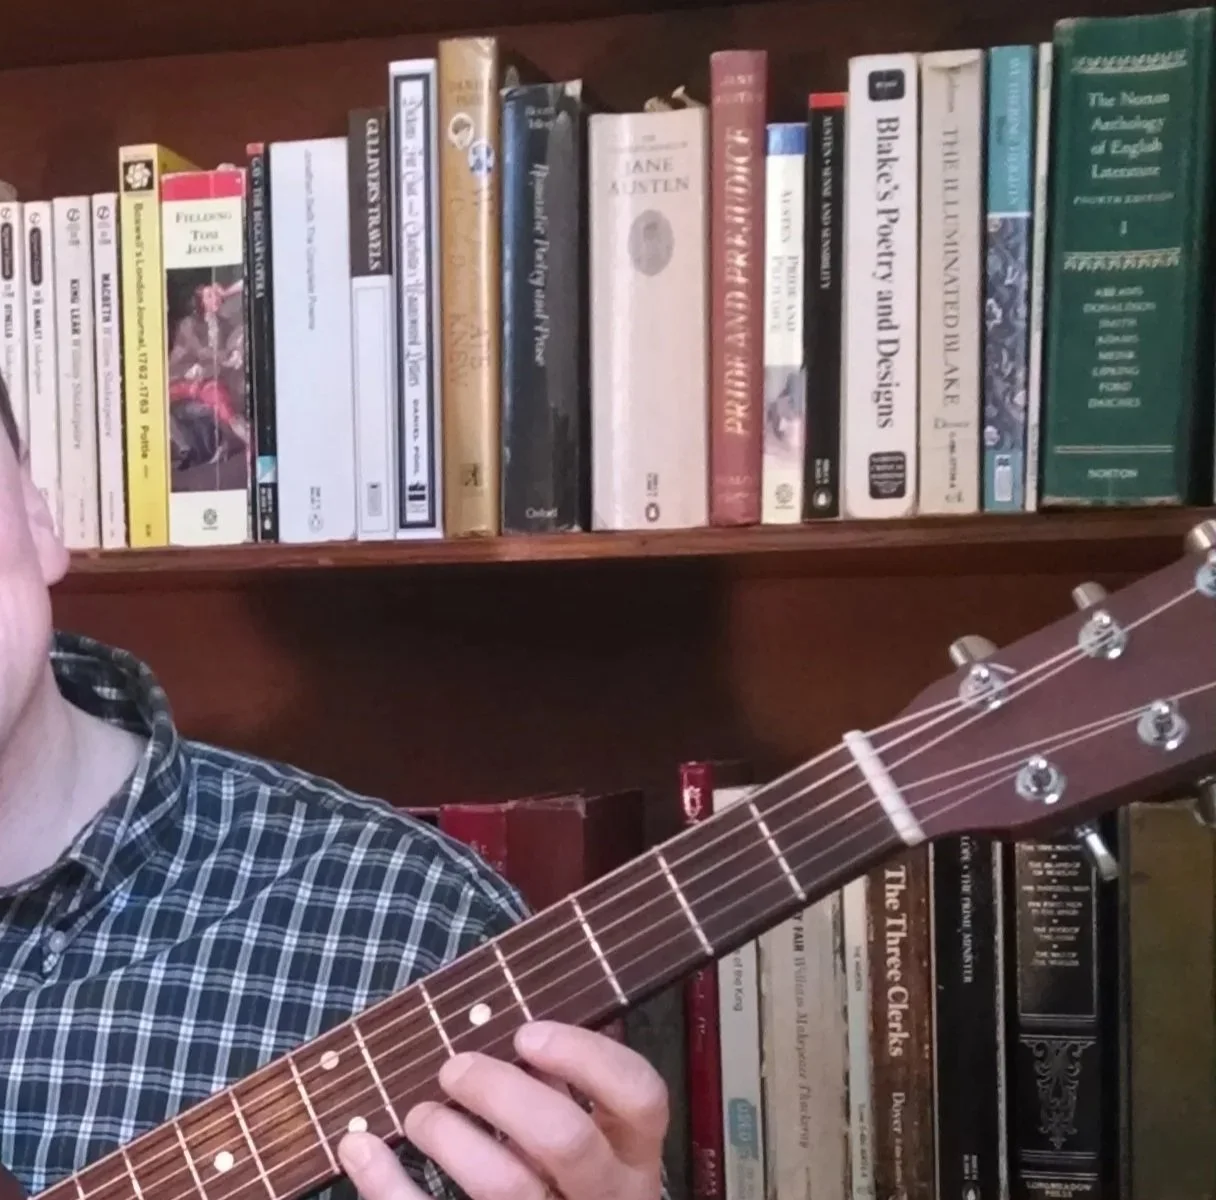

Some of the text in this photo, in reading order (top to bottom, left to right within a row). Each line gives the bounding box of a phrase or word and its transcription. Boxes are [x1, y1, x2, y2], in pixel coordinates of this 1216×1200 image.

[1087, 91, 1116, 108] The
[1090, 114, 1166, 135] Anthology
[625, 157, 674, 174] JANE
[875, 116, 902, 203] Blake's
[943, 129, 960, 172] THE
[1090, 136, 1163, 160] of English
[1091, 163, 1161, 179] Literature
[607, 176, 691, 196] AUSTEN
[819, 115, 834, 290] AUSTEN SENSE AND SENSIBILITY
[133, 202, 144, 258] Boswell's
[367, 204, 383, 270] TRAVELS
[871, 207, 901, 284] Poetry
[943, 178, 961, 329] ILLUMINATED
[69, 278, 80, 304] KING
[101, 273, 111, 323] MACBETH
[135, 260, 145, 299] London
[723, 126, 753, 438] PRIDE AND PREJUDICE
[70, 308, 81, 335] LEAR
[875, 290, 901, 333] and
[872, 339, 902, 430] Designs
[943, 333, 961, 409] BLAKE
[1086, 467, 1139, 479] NORTON
[793, 927, 804, 952] FAIR
[961, 874, 973, 984] THE PRIME MINISTER
[732, 957, 745, 1011] of the King
[794, 956, 806, 1007] William
[883, 864, 910, 1058] The Three Clerks
[795, 1011, 810, 1079] Makepeace
